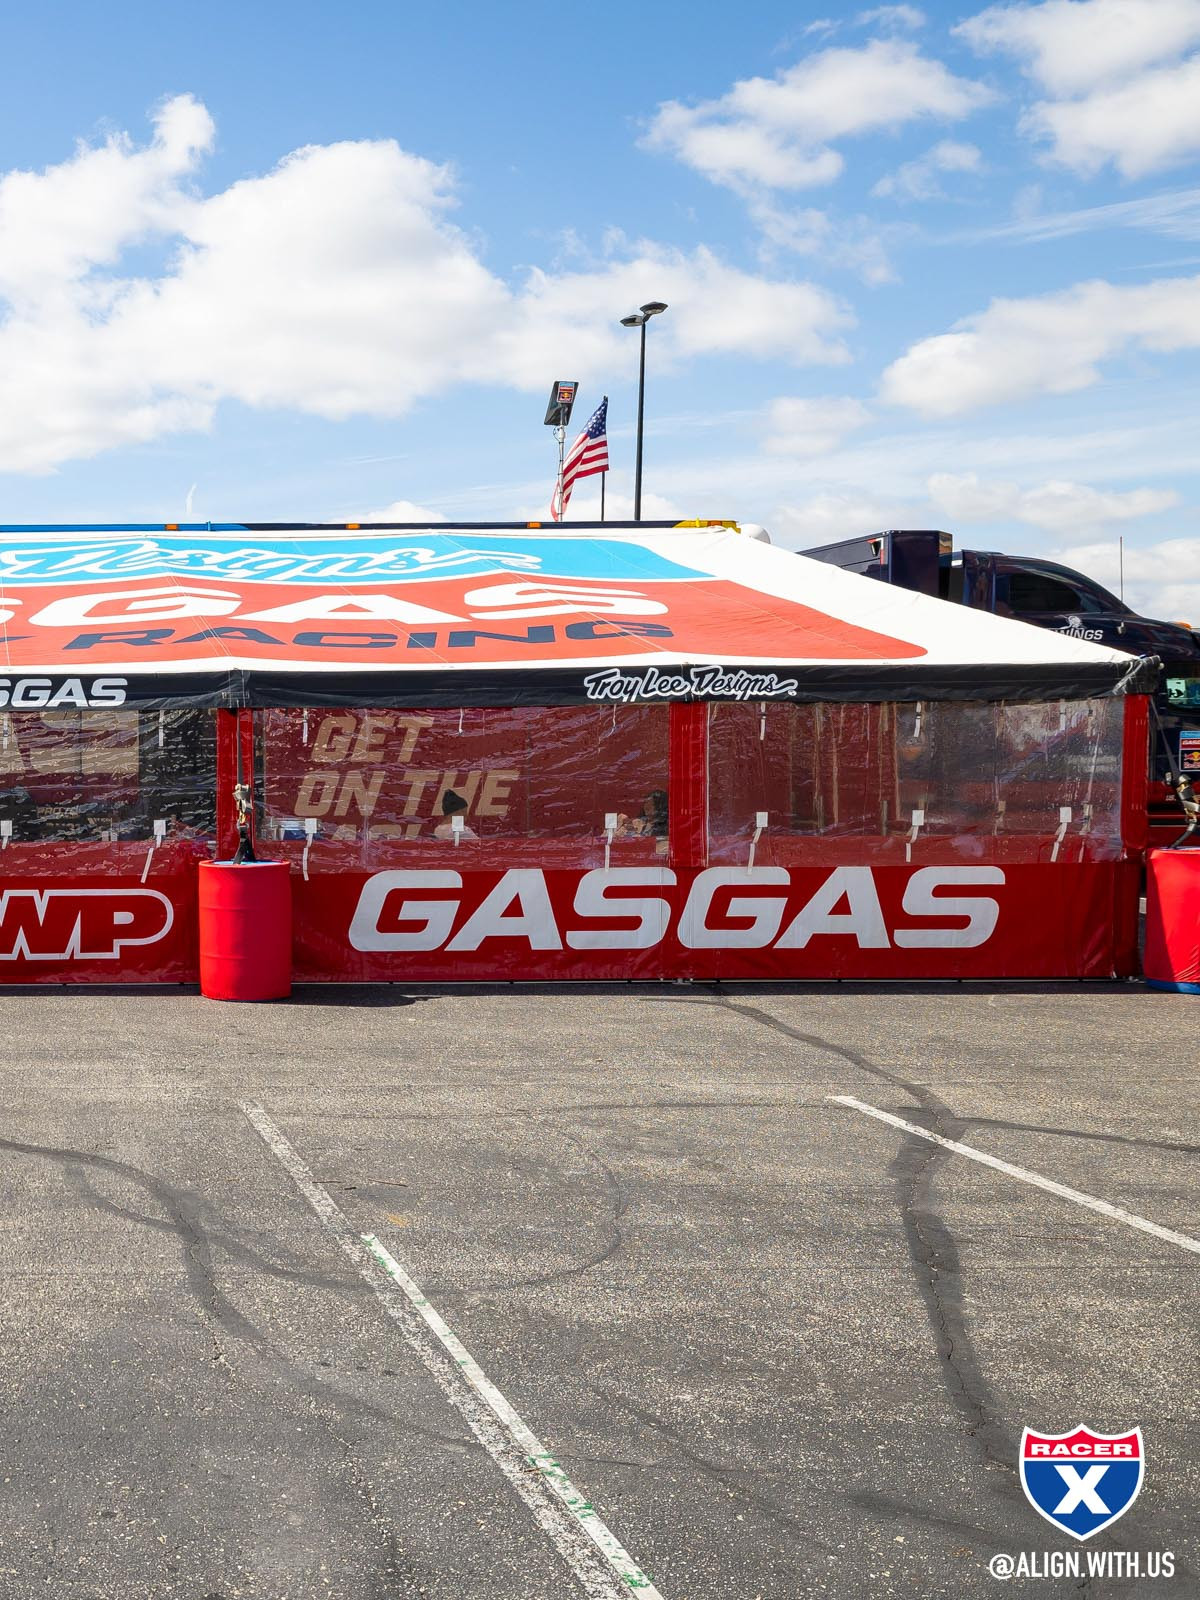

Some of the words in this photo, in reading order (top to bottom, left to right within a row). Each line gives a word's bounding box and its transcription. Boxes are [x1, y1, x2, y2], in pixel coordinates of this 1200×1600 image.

[62, 621, 674, 650] RACING
[690, 665, 799, 701] Designs
[311, 716, 435, 763] GET
[294, 770, 386, 817] ON
[402, 769, 521, 817] THE
[348, 866, 1006, 951] GASGAS
